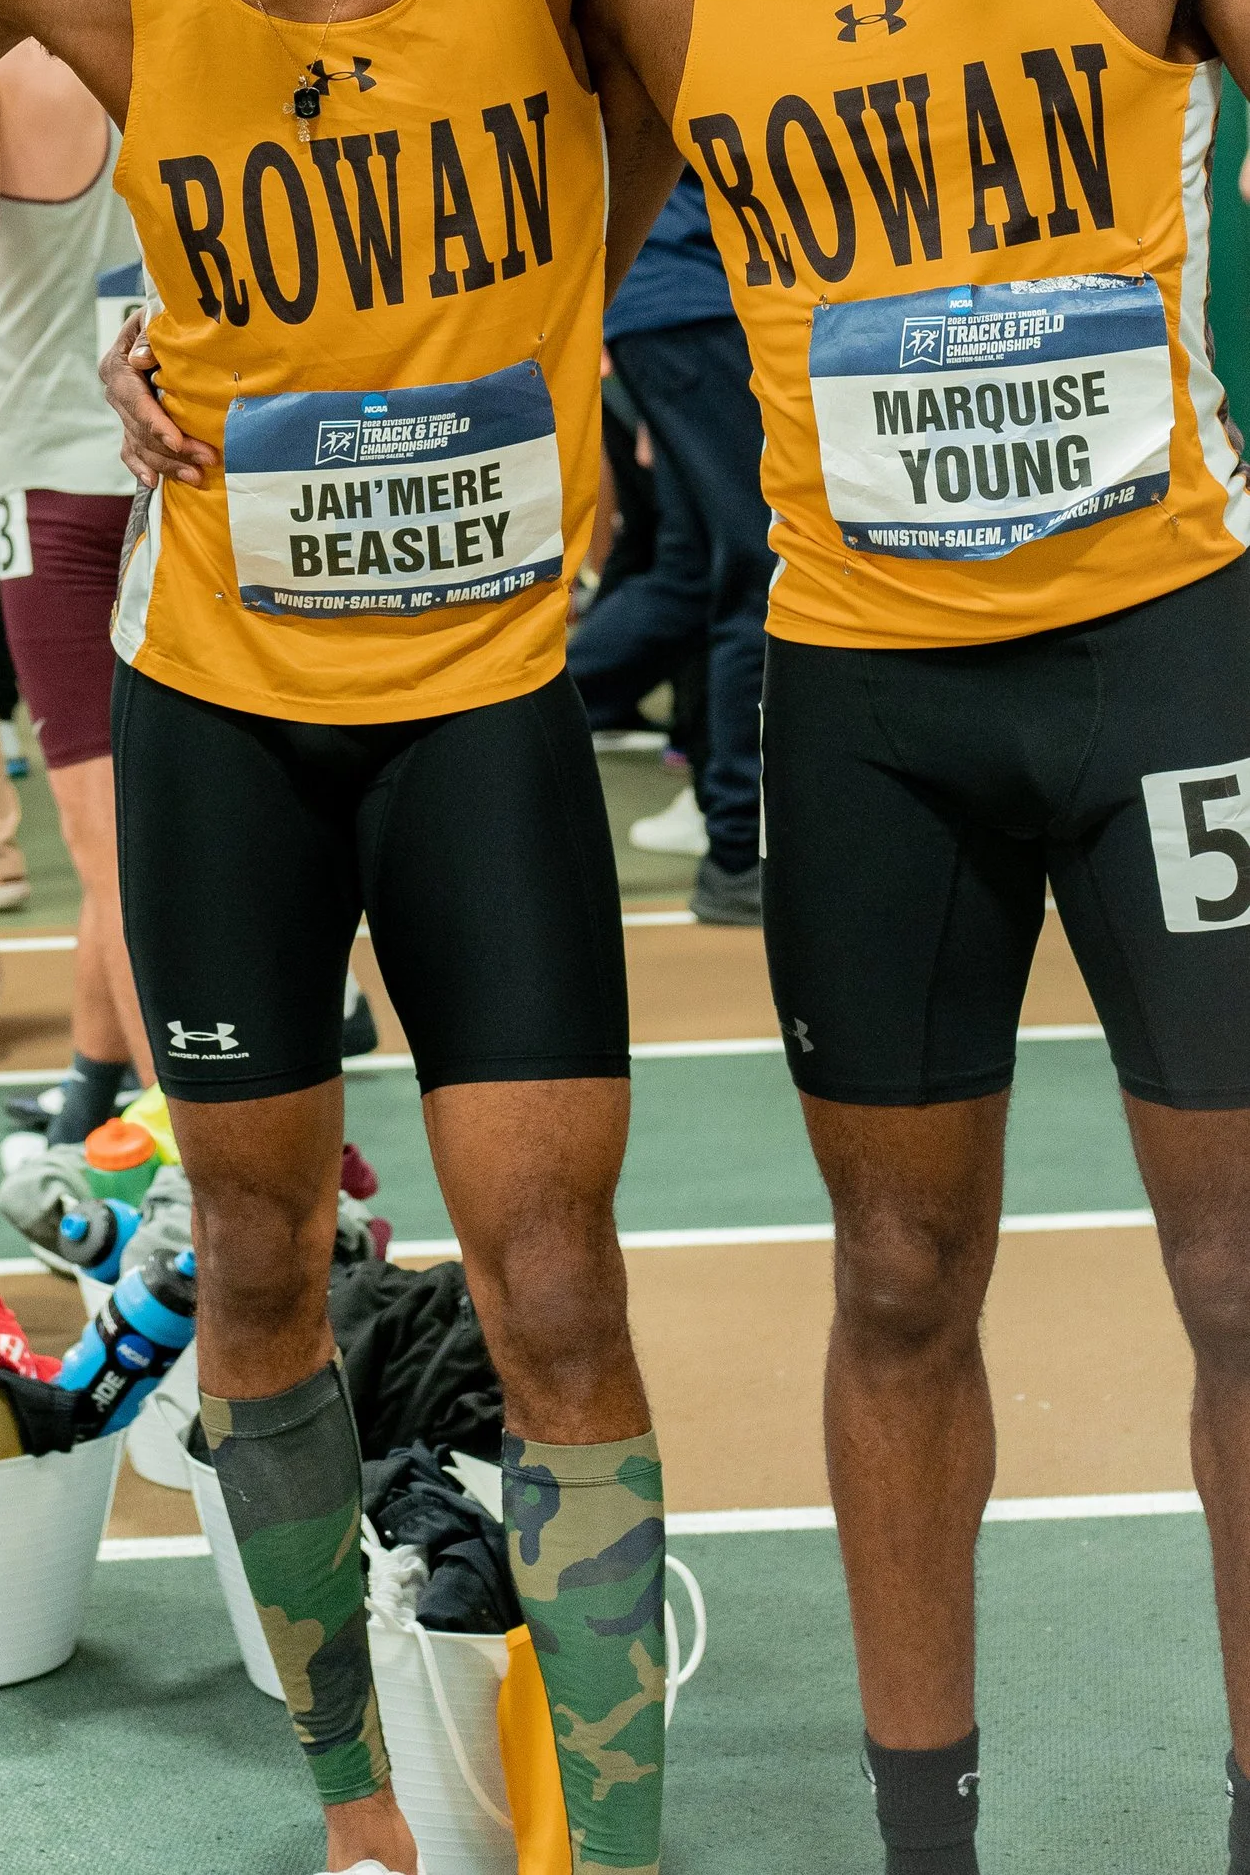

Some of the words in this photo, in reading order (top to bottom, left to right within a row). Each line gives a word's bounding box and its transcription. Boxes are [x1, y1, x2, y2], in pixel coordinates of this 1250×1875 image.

[689, 43, 1115, 289] ROWAN
[159, 91, 554, 327] ROWAN
[947, 316, 967, 325] 2022
[967, 313, 1004, 325] DIVISION
[1005, 311, 1016, 320] III
[1018, 308, 1047, 319] INDOOR
[949, 300, 973, 309] NCAA
[947, 321, 1002, 343] TRACK
[1004, 320, 1017, 339] &
[1019, 314, 1065, 337] FIELD
[946, 337, 1041, 357] CHAMPIONSHIPS
[362, 420, 381, 428] 2022
[382, 417, 416, 426] DIVISION
[428, 412, 456, 422] INDOOR
[364, 405, 388, 414] NCAA
[872, 370, 1109, 436] MARQUISE
[361, 437, 448, 455] CHAMPIONSHIPS
[362, 426, 412, 444] TRACK
[415, 425, 427, 440] &
[428, 417, 470, 438] FIELD
[899, 434, 1092, 504] YOUNG
[289, 462, 503, 523] JAH'MERE
[868, 527, 1005, 548] WINSTON-SALEM,
[1011, 523, 1035, 543] NC
[1103, 486, 1136, 510] 11-12
[289, 510, 511, 577] BEASLEY
[274, 591, 406, 610] WINSTON-SALEM,
[410, 592, 432, 607] NC
[446, 580, 500, 603] MARCH
[502, 570, 535, 593] 11-12
[1179, 774, 1250, 922] 5
[168, 1051, 200, 1060] UNDER
[201, 1052, 249, 1060] ARMOUR
